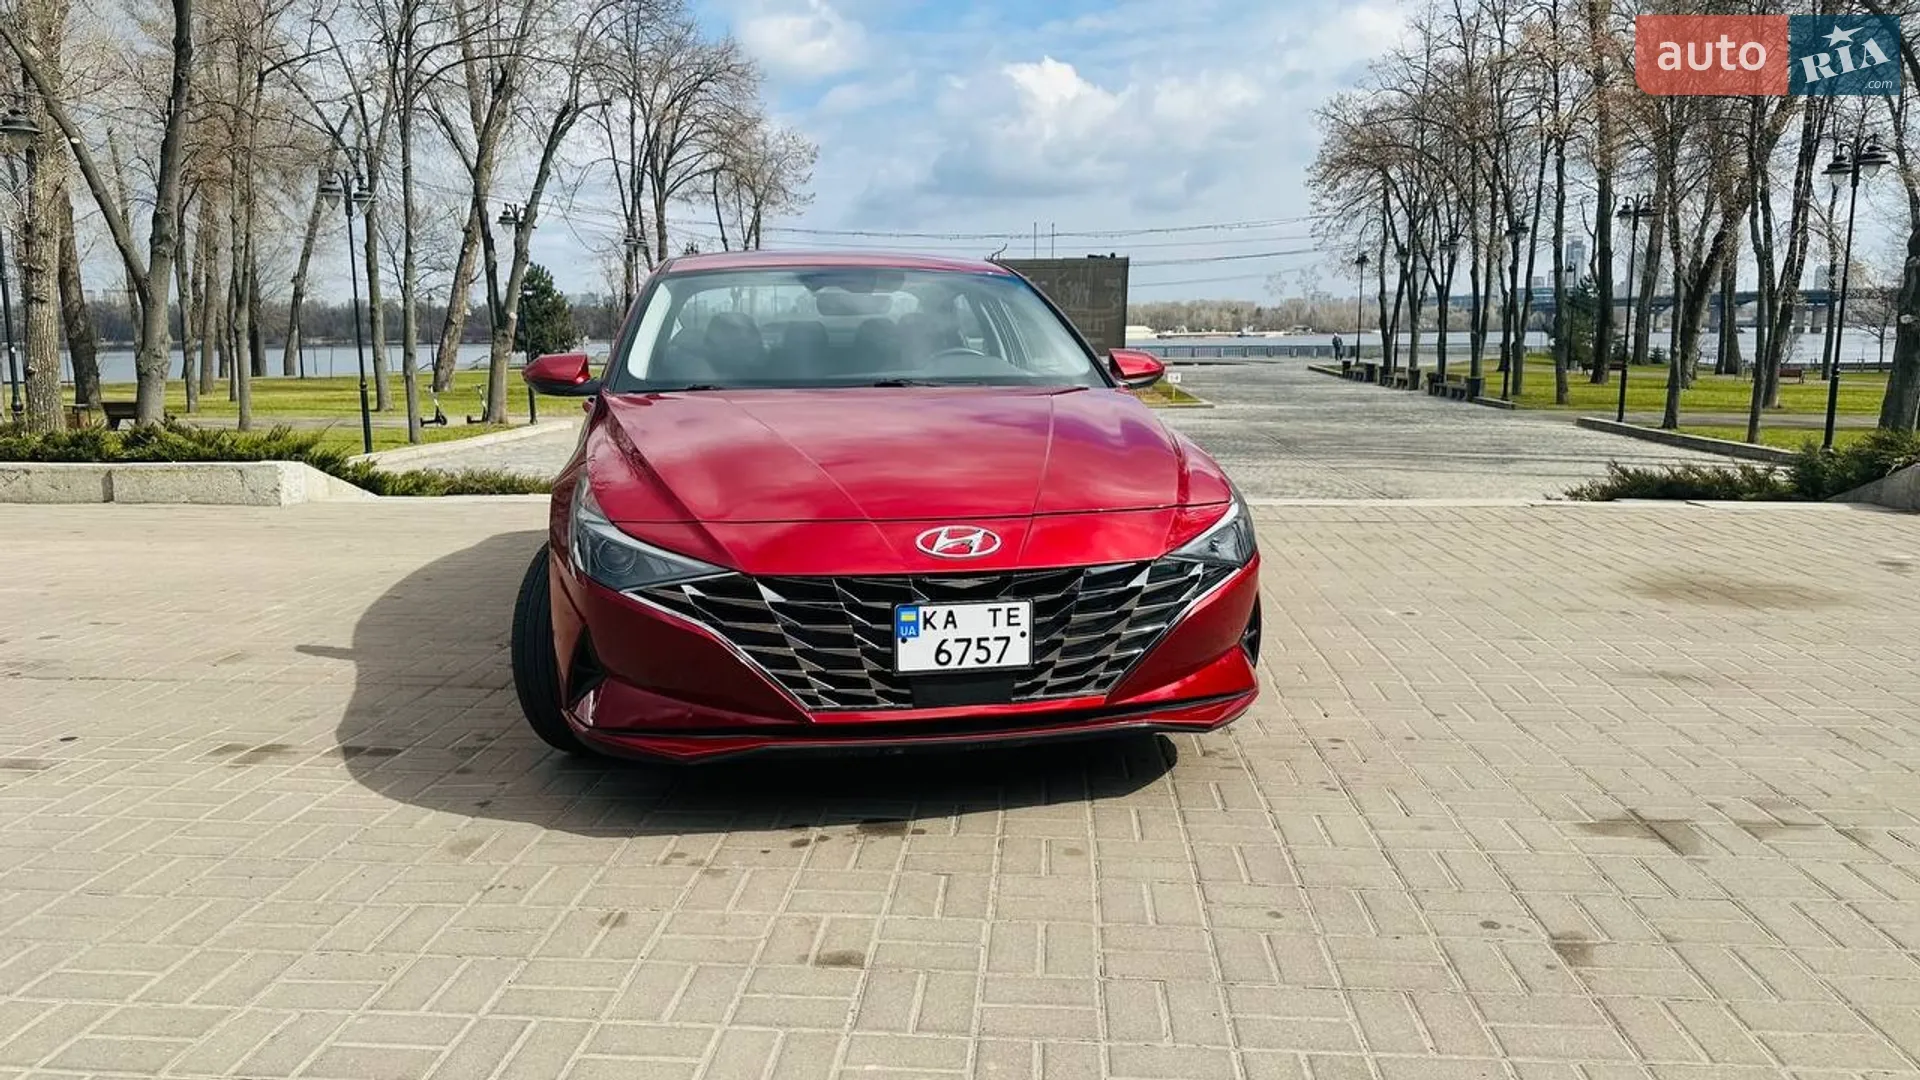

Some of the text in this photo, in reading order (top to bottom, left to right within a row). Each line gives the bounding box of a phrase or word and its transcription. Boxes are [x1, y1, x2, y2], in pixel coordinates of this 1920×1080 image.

[922, 607, 1021, 630] KA TE
[901, 626, 917, 636] UA
[934, 636, 1011, 666] 6757
